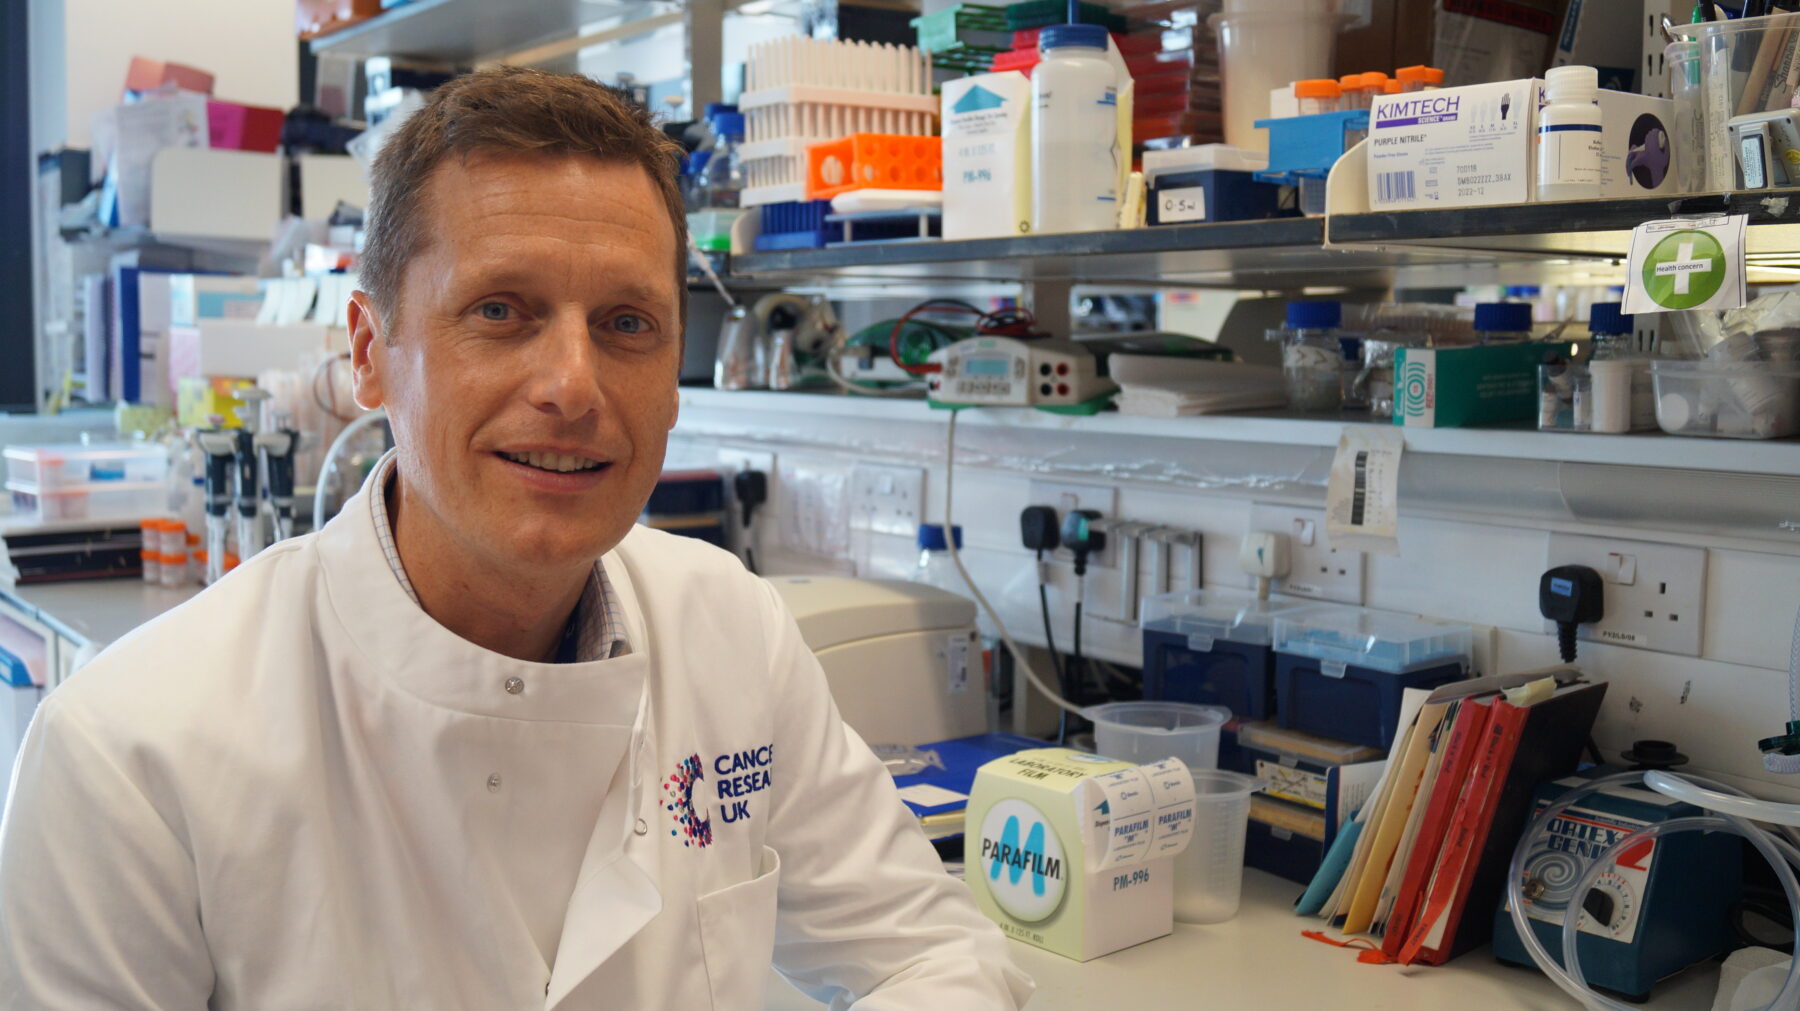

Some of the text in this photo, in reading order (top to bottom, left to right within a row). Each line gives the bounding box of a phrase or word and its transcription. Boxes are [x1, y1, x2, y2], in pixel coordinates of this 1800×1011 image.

[1376, 96, 1460, 120] KIMTECH
[1374, 137, 1398, 146] PURPLE
[1656, 263, 1704, 273] Health concern
[1009, 758, 1087, 779] LABORATORY
[1017, 768, 1050, 781] FILM
[720, 800, 750, 823] UK
[1158, 808, 1192, 825] PARAFILM
[1114, 819, 1149, 837] PARAFILM
[982, 837, 1060, 880] PARAFILM
[1113, 868, 1150, 891] PM-996
